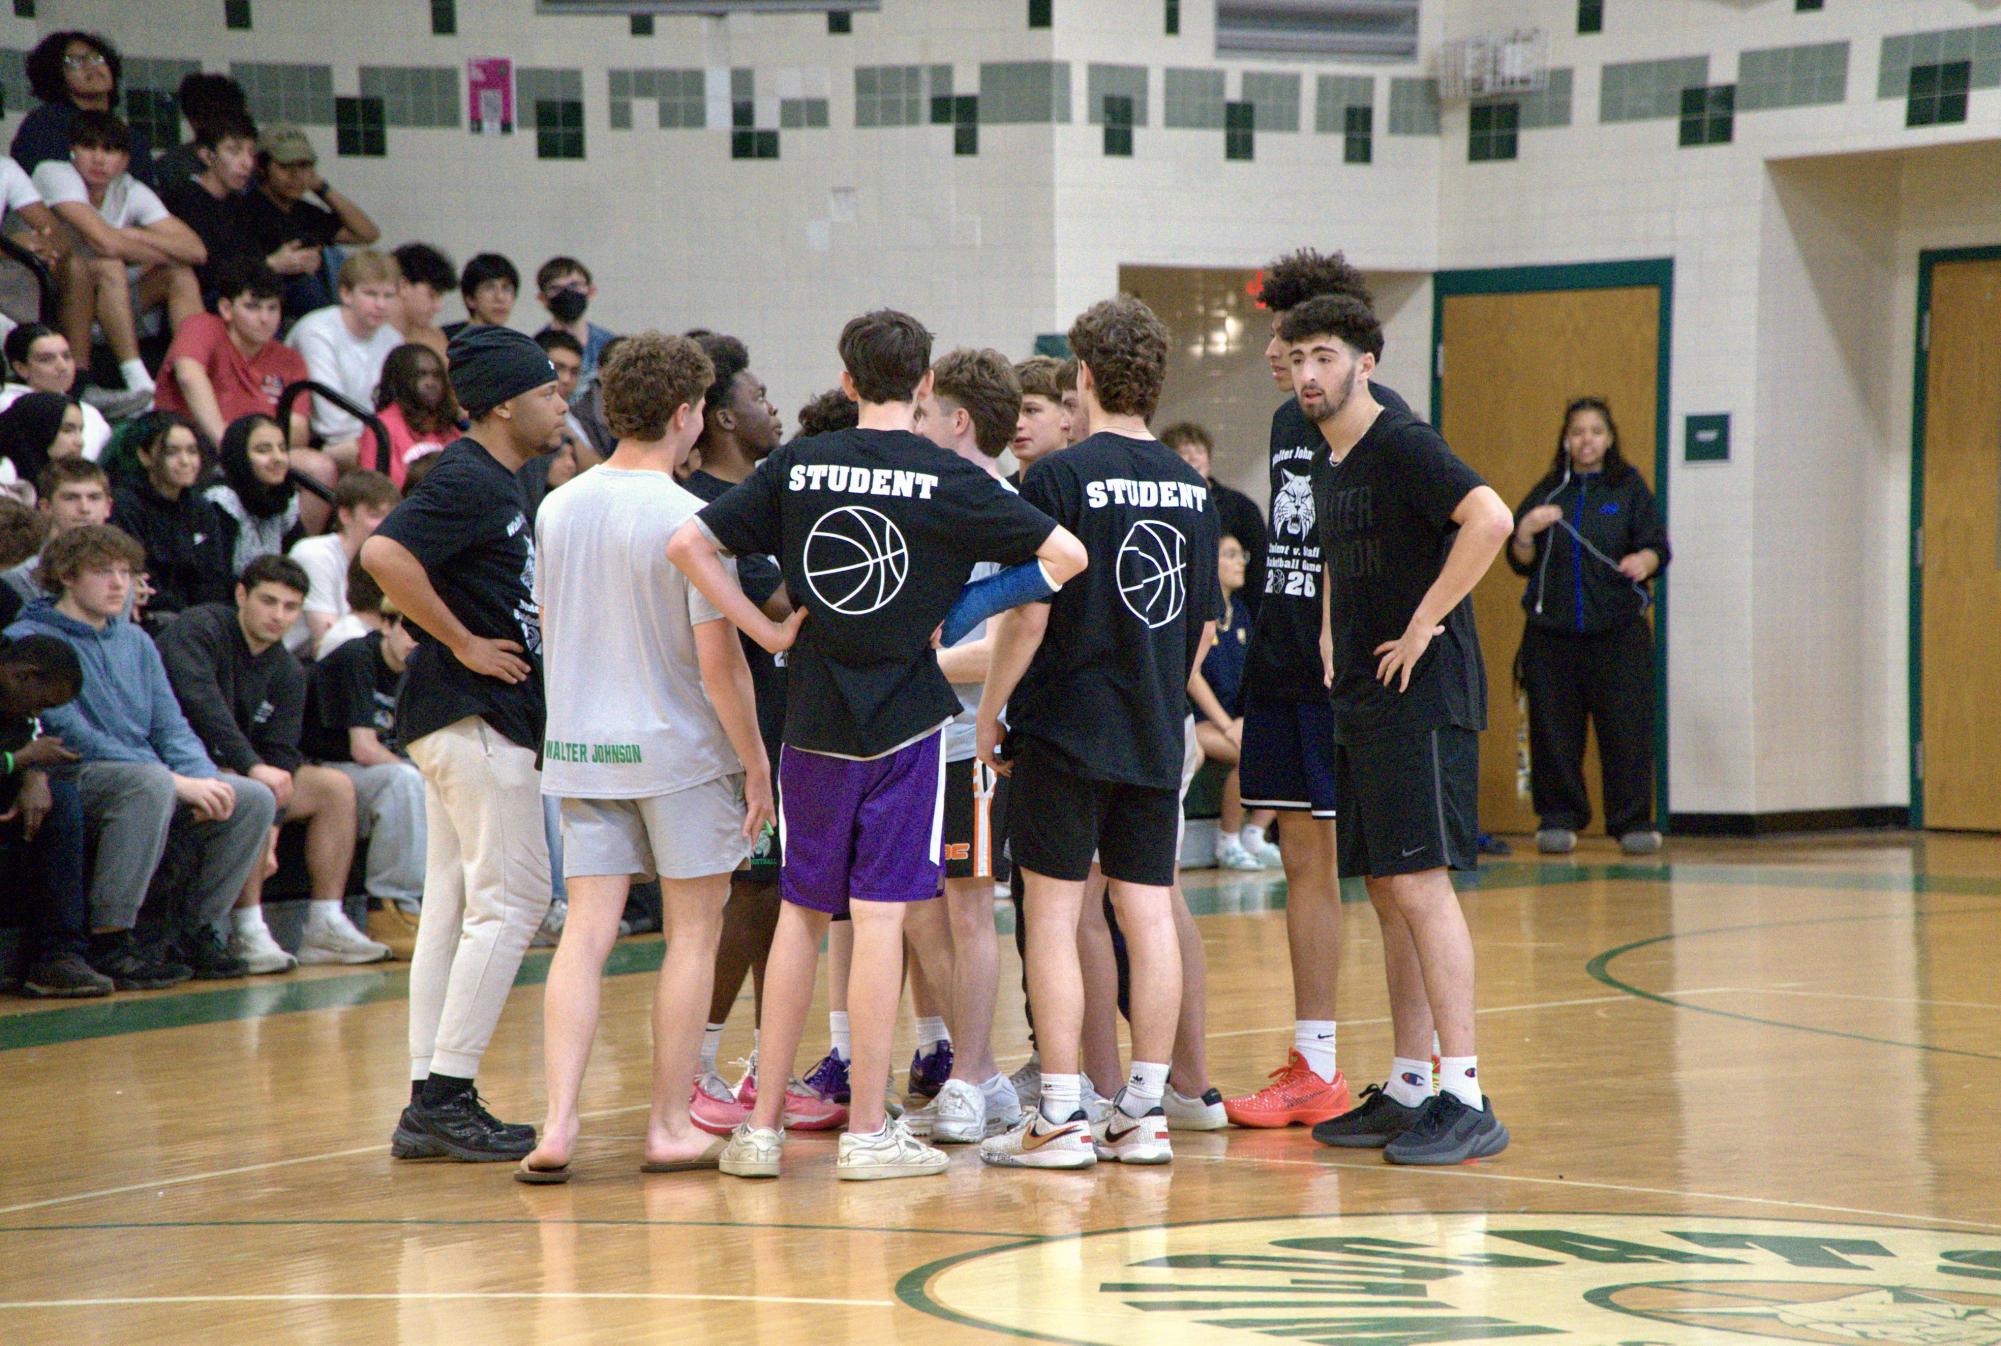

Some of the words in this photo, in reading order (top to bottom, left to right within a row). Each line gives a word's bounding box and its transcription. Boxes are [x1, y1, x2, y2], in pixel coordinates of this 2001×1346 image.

[1294, 446, 1315, 461] John
[789, 464, 939, 500] STUDENT
[1086, 478, 1207, 513] STUDENT
[546, 740, 588, 763] WALTER
[591, 743, 643, 764] JOHNSON
